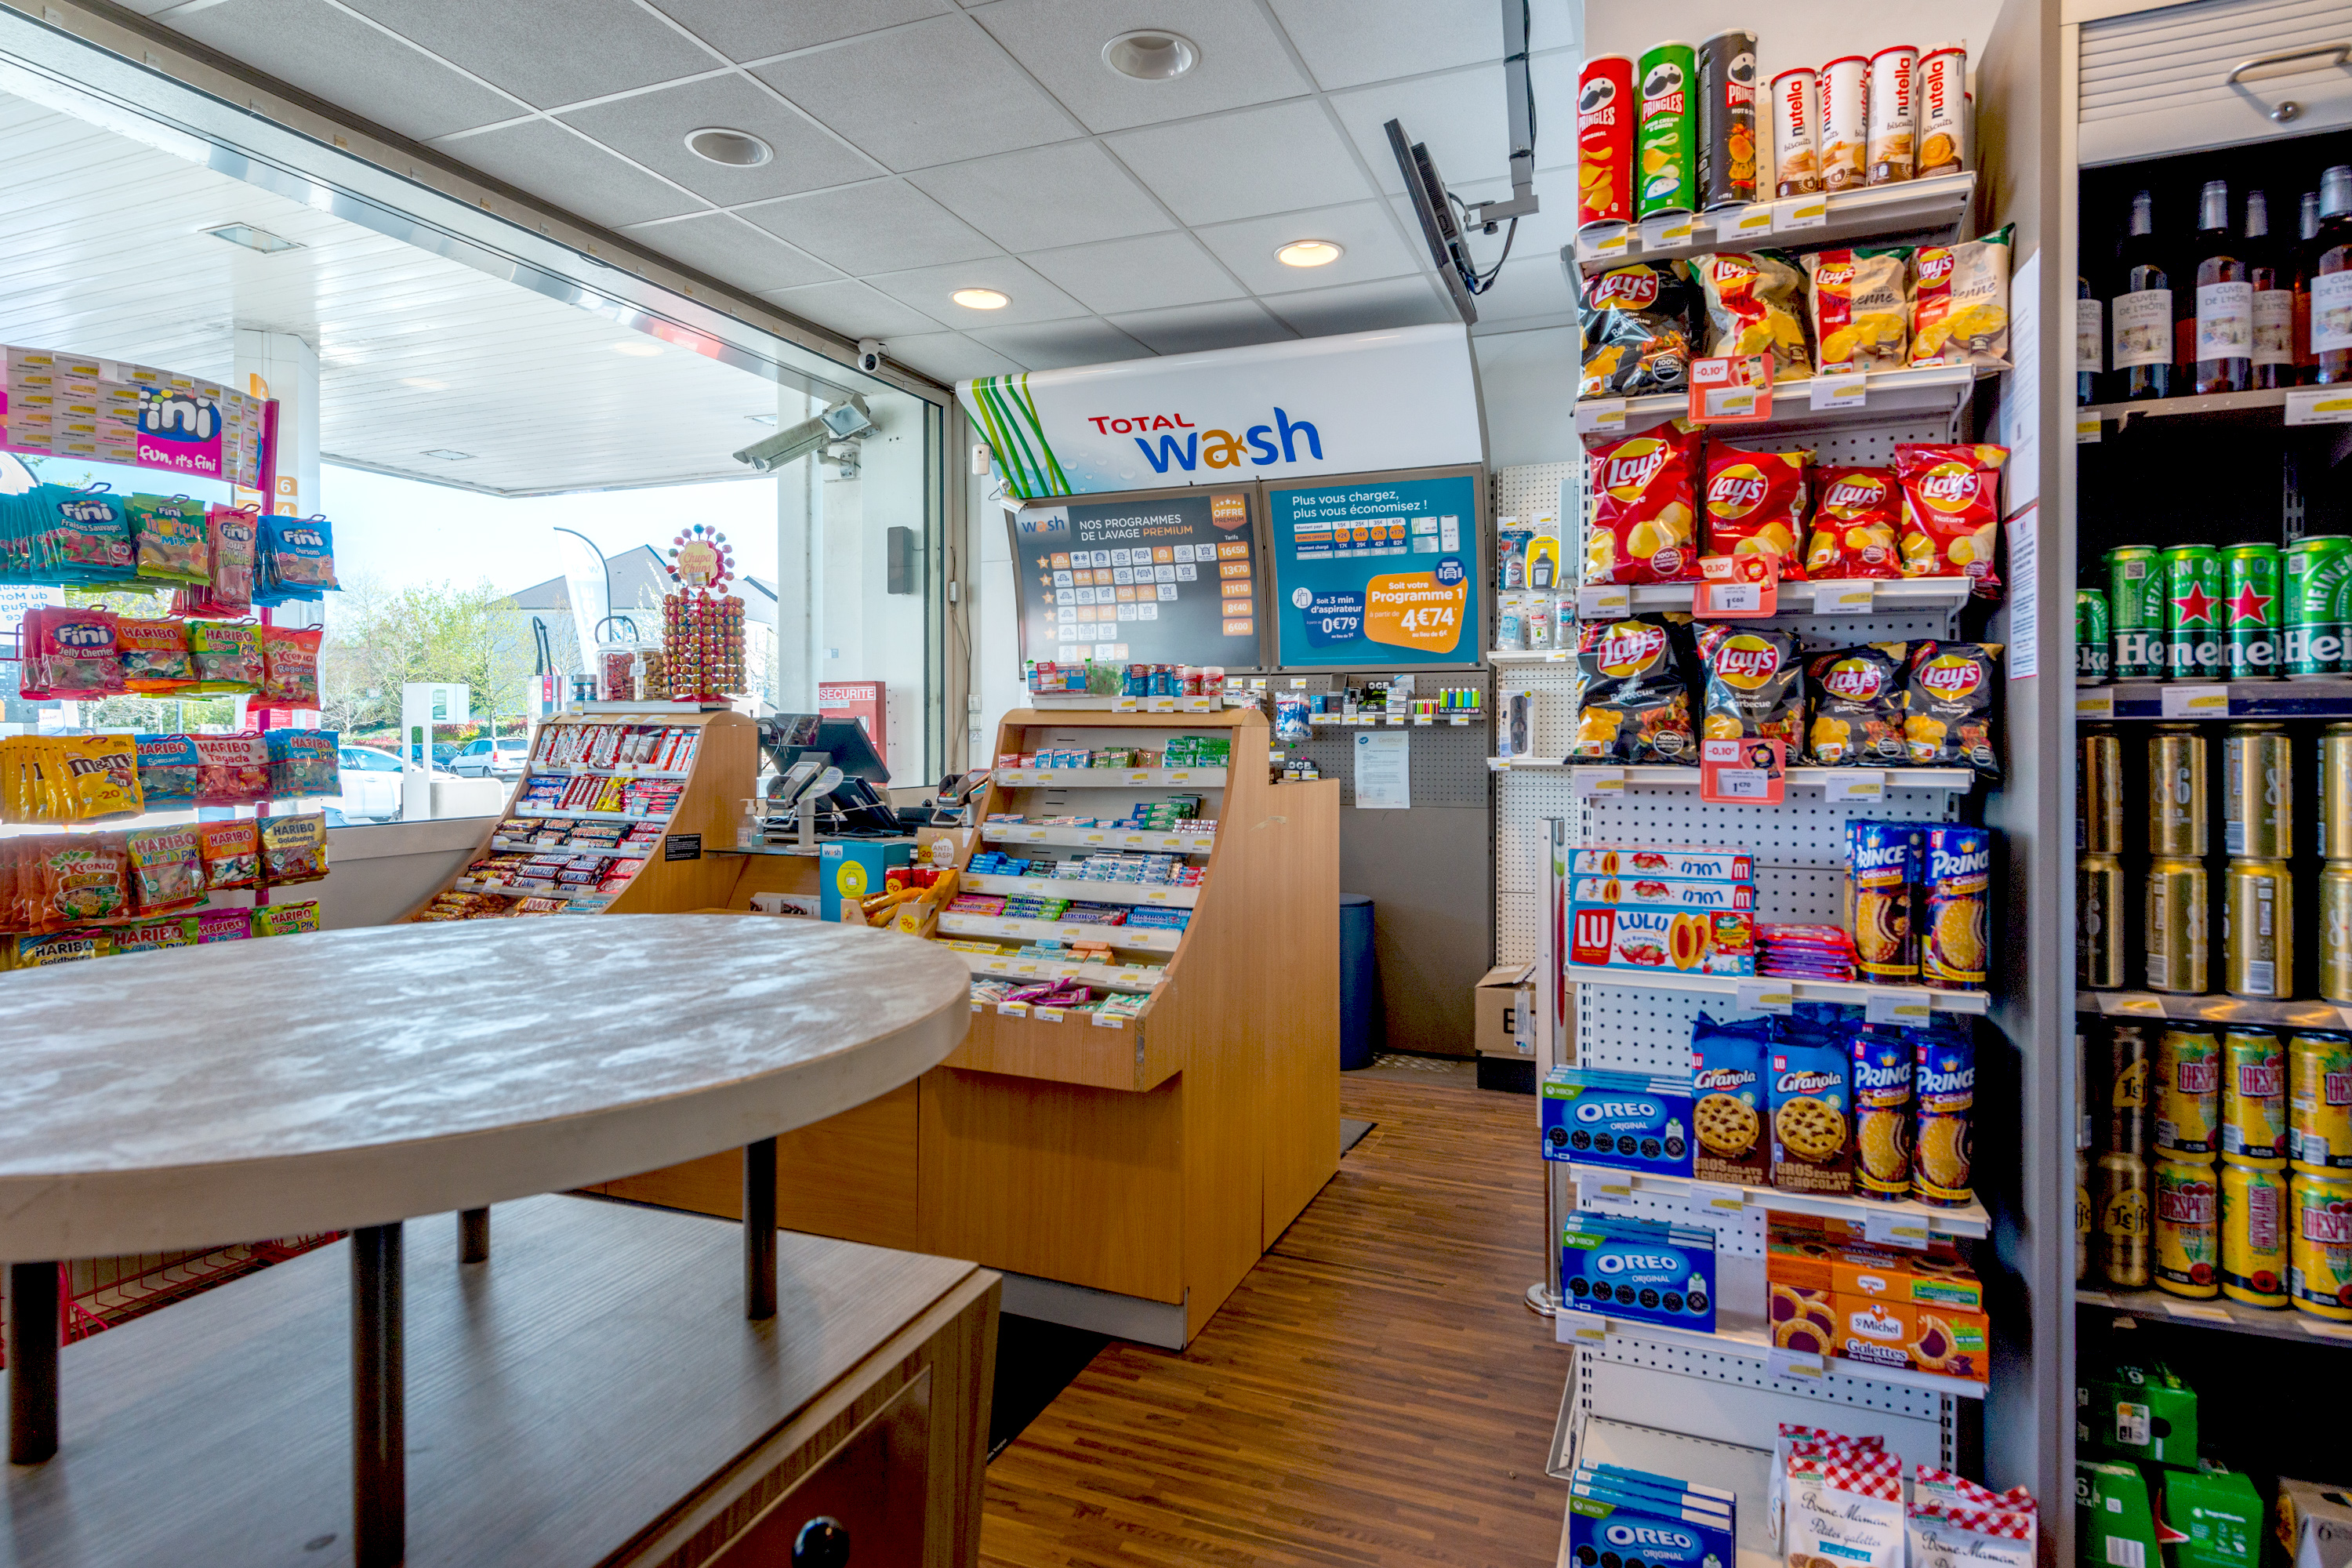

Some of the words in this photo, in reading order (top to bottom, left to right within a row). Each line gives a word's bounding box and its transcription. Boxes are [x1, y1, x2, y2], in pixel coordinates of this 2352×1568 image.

[1895, 58, 1911, 116] nutella
[1928, 61, 1944, 118] nutella
[1642, 93, 1682, 121] PRINGLES
[1788, 81, 1803, 136] nutella
[1823, 74, 1831, 132] nutella
[1579, 107, 1615, 135] PRINGLES
[1659, 118, 1679, 126] CREAM
[1887, 120, 1914, 130] biscuits
[1582, 131, 1606, 141] ORIGINAL
[1817, 268, 1855, 285] Lay's
[1594, 273, 1653, 304] Lay's
[1088, 413, 1195, 435] TOTAL
[1134, 407, 1323, 474] wash
[1608, 446, 1665, 488] Lay's
[1708, 477, 1764, 506] Lay's
[1923, 471, 1976, 502] Lay's
[1293, 495, 1316, 506] Plus
[1319, 495, 1345, 504] vous
[1348, 491, 1399, 503] chargez,
[1828, 487, 1882, 507] Lay's
[61, 503, 112, 521] Fini
[158, 506, 181, 517] Fini
[1294, 509, 1316, 521] plus
[1319, 508, 1347, 517] vous
[1350, 502, 1421, 515] économisez
[1424, 500, 1428, 510] !
[1022, 516, 1065, 533] wash
[1080, 521, 1102, 530] NOS
[1105, 514, 1181, 528] PROGRAMMES
[1933, 514, 1965, 524] Nature
[89, 524, 122, 533] Sauvages
[1081, 532, 1096, 541] DE
[1098, 528, 1140, 540] LAVAGE
[1143, 525, 1192, 537] PREMIUM
[284, 531, 323, 546] Fini
[1221, 546, 1246, 557] 16€50
[1223, 564, 1247, 575] 13€70
[1225, 584, 1248, 594] 11€10
[1372, 590, 1453, 604] Programme
[1457, 588, 1462, 599] 1
[1228, 603, 1247, 613] 8€40
[1311, 605, 1362, 614] d'aspirateur
[60, 626, 108, 644] Fini
[122, 627, 178, 640] HARIBO
[1228, 622, 1248, 632] 6€00
[205, 630, 253, 642] HARIBO
[59, 647, 79, 658] Jelly
[82, 648, 114, 657] Cherries
[208, 641, 235, 651] Langue
[1602, 629, 1661, 667] Lay's
[1719, 648, 1775, 677] Lay's
[1924, 664, 1977, 690] Lay's
[819, 689, 875, 700] SECURITE
[135, 742, 187, 755] HARIBO
[198, 742, 252, 753] HARIBO
[291, 737, 332, 750] HARIBO
[578, 736, 587, 754] bueno
[595, 733, 605, 753] bueno
[607, 737, 615, 757] bueno
[208, 753, 249, 764] Tagada
[1288, 761, 1312, 770] OCB
[97, 790, 120, 800] -20
[539, 786, 561, 797] CRUNCH
[274, 823, 315, 836] HARIBO
[134, 832, 198, 855] HARIBO
[209, 829, 253, 847] HARIBO
[278, 835, 314, 844] Goldbears
[539, 855, 571, 863] SNICKERS
[1857, 844, 1907, 868] PRINCE
[527, 866, 557, 877] SNICKERS
[571, 861, 597, 869] SNICKERS
[1682, 861, 1722, 876] LULU
[561, 873, 589, 882] SNICKERS
[525, 897, 559, 910] TWIX
[1011, 897, 1045, 906] mentos
[1682, 890, 1723, 904] LULU
[270, 909, 311, 924] HARIBO
[1618, 913, 1668, 931] LULU
[198, 919, 245, 935] HARIBO
[274, 924, 296, 934] Langue
[1578, 914, 1608, 948] LU
[113, 927, 183, 947] HARIBO
[36, 940, 94, 958] HARIBO
[1695, 1070, 1756, 1090] Granola
[1777, 1072, 1842, 1092] Granola
[1577, 1103, 1655, 1122] OREO
[1610, 1122, 1648, 1131] ORIGINAL
[1786, 1177, 1850, 1191] CHOCOLAT
[1598, 1254, 1678, 1273] OREO
[1632, 1275, 1670, 1284] ORIGINAL
[1847, 1340, 1907, 1359] Galettes
[1802, 1491, 1838, 1518] Bonne
[1607, 1526, 1691, 1548] OREO
[1845, 1532, 1882, 1548] galettes
[1642, 1549, 1683, 1561] ORIGINAL
